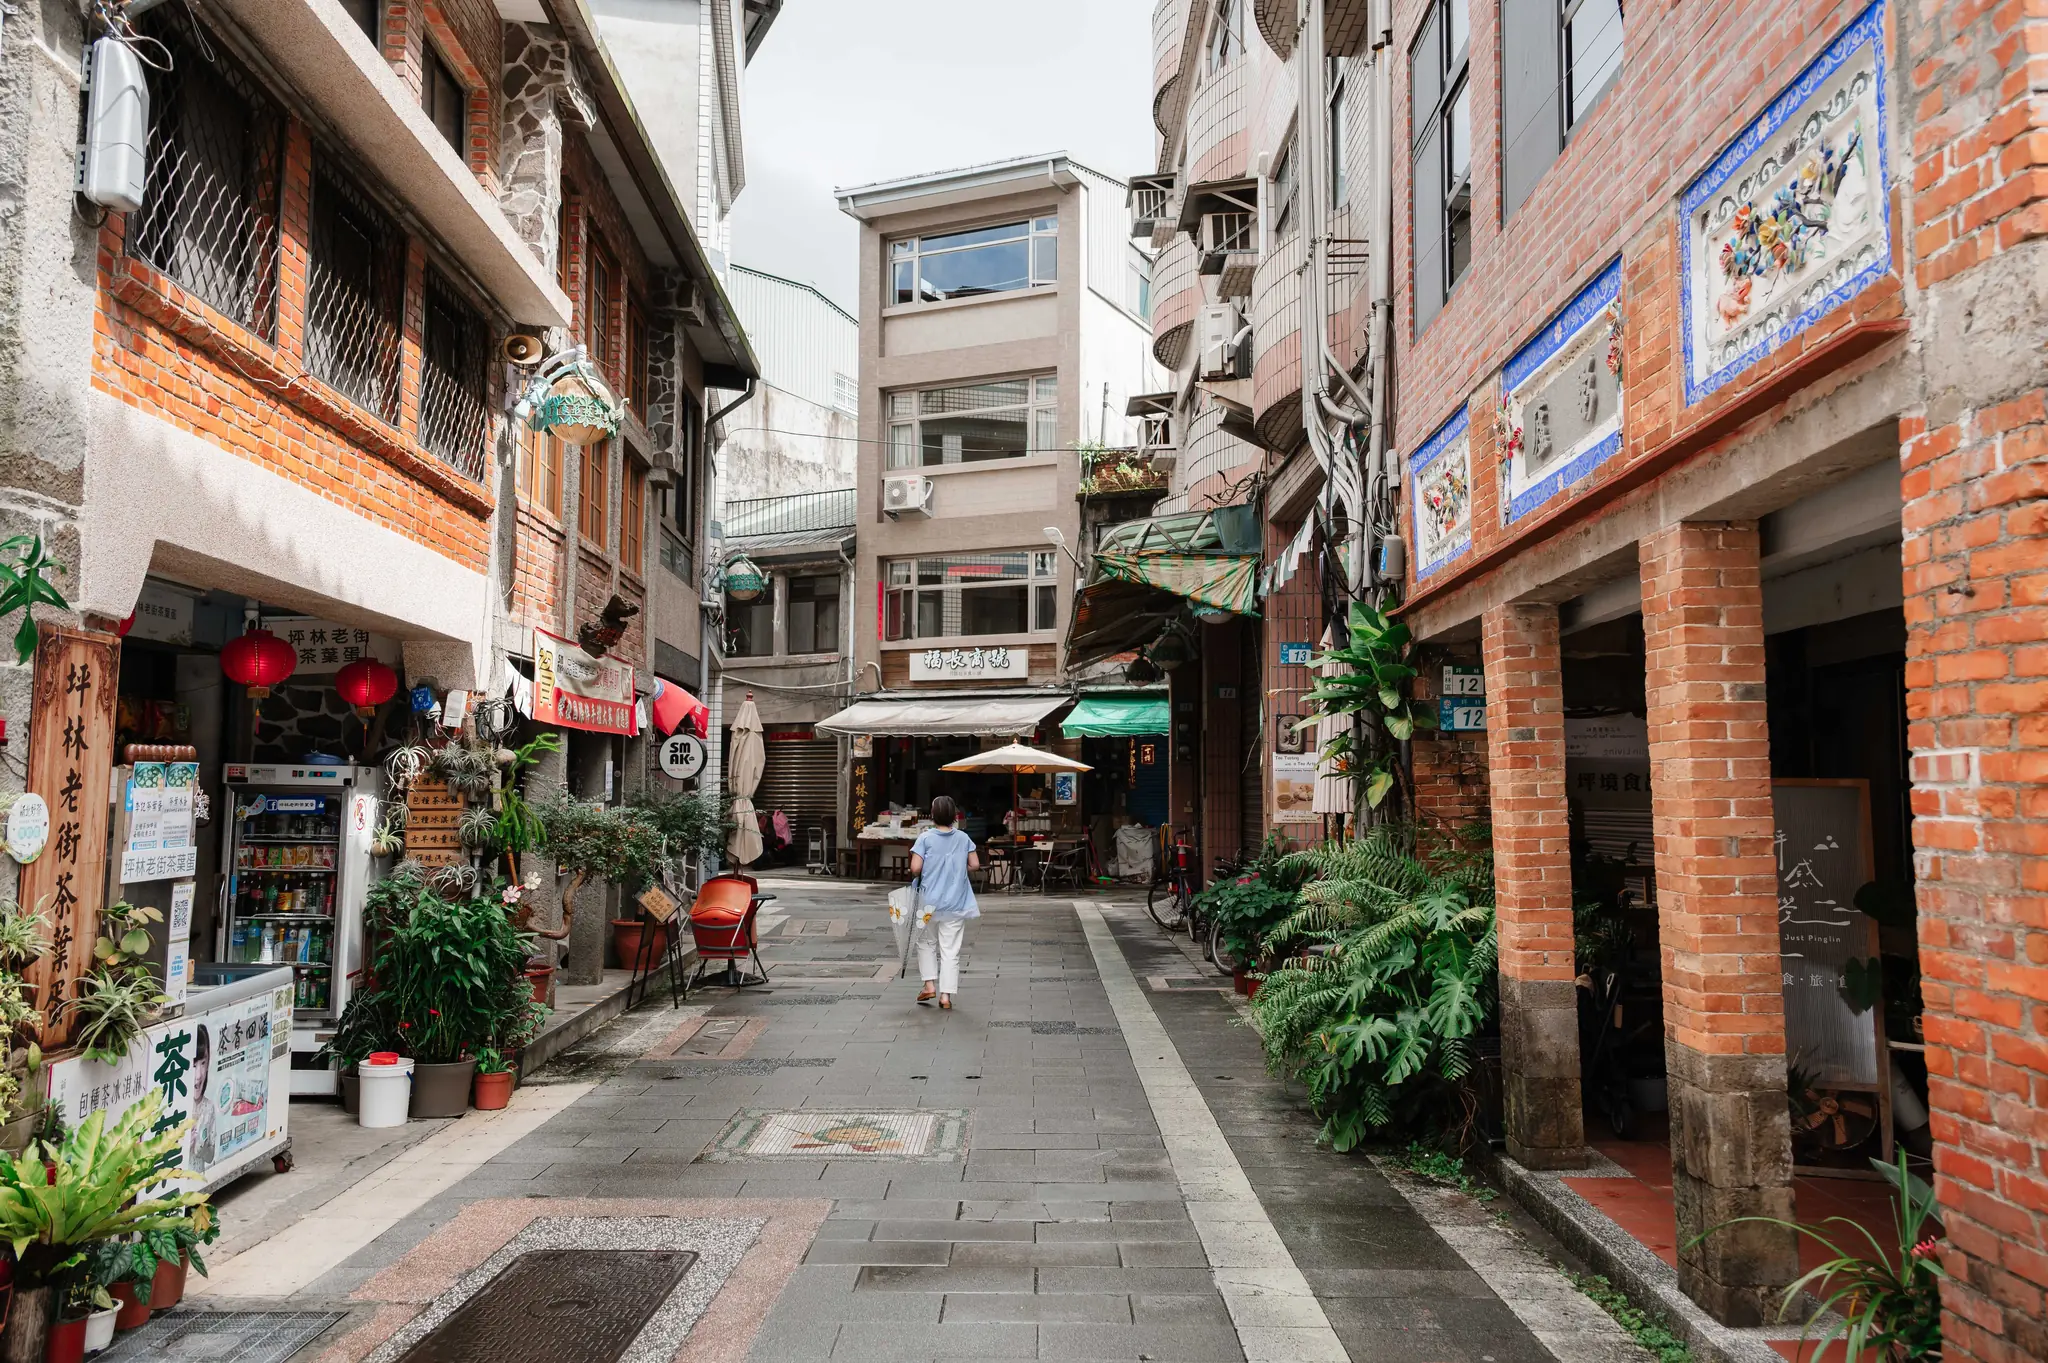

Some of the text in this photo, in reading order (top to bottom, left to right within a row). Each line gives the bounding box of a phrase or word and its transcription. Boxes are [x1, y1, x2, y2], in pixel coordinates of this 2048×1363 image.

[288, 628, 370, 644] 坪林老街
[299, 646, 361, 665] 茶葉蛋
[924, 647, 1010, 669] 福長商號
[1295, 650, 1307, 662] 13
[1444, 669, 1452, 692] 坪林區
[1459, 677, 1479, 692] 12
[1463, 709, 1484, 727] 12
[853, 764, 869, 833] 坪林老街
[47, 663, 93, 1030] 坪林老街茶葉蛋
[124, 852, 196, 878] 坪林老街茶葉蛋
[1785, 933, 1842, 944] Just Pinglin
[217, 1012, 269, 1056] 茶香四溢
